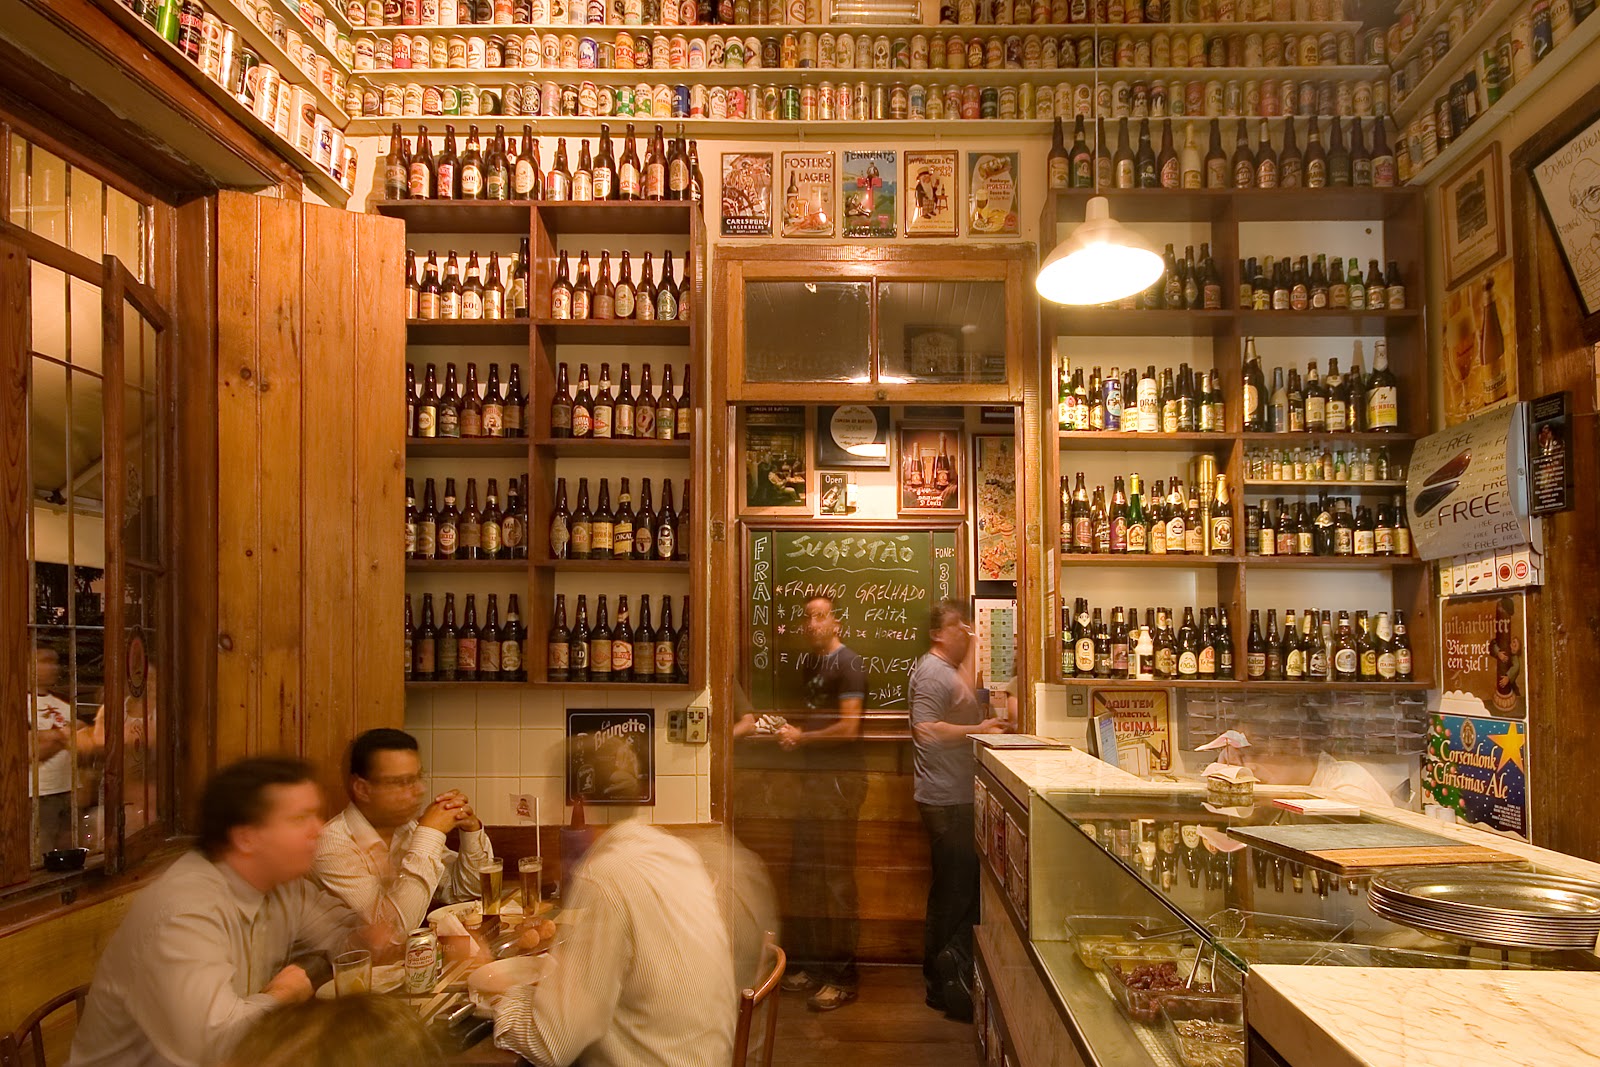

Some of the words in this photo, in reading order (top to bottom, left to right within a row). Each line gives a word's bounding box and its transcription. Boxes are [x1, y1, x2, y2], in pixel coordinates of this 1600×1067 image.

[785, 157, 832, 168] FOSTER'S
[799, 172, 831, 182] LAGER
[1437, 432, 1474, 455] FREE
[825, 474, 843, 485] Open
[1438, 492, 1500, 526] FREE
[786, 534, 915, 567] SUGESTÃO
[1474, 538, 1499, 550] FREE
[935, 547, 955, 559] FONE:
[784, 580, 847, 600] FRANGO
[855, 580, 926, 604] GRELHADO
[864, 605, 907, 624] FRITA
[857, 630, 867, 638] DE
[875, 627, 918, 641] HORTELÃ
[1446, 639, 1469, 655] Bier
[1471, 640, 1490, 655] met
[796, 652, 840, 670] MUITA
[851, 655, 919, 676] CERVEJA
[1447, 657, 1463, 668] een
[1106, 700, 1130, 708] AQUI
[1133, 700, 1154, 708] TEM
[1113, 716, 1165, 732] RIGINAL.
[594, 718, 646, 751] Brunette
[1440, 739, 1498, 771] Corsendonk
[1434, 762, 1486, 795] Christmas
[1485, 772, 1508, 800] Ale
